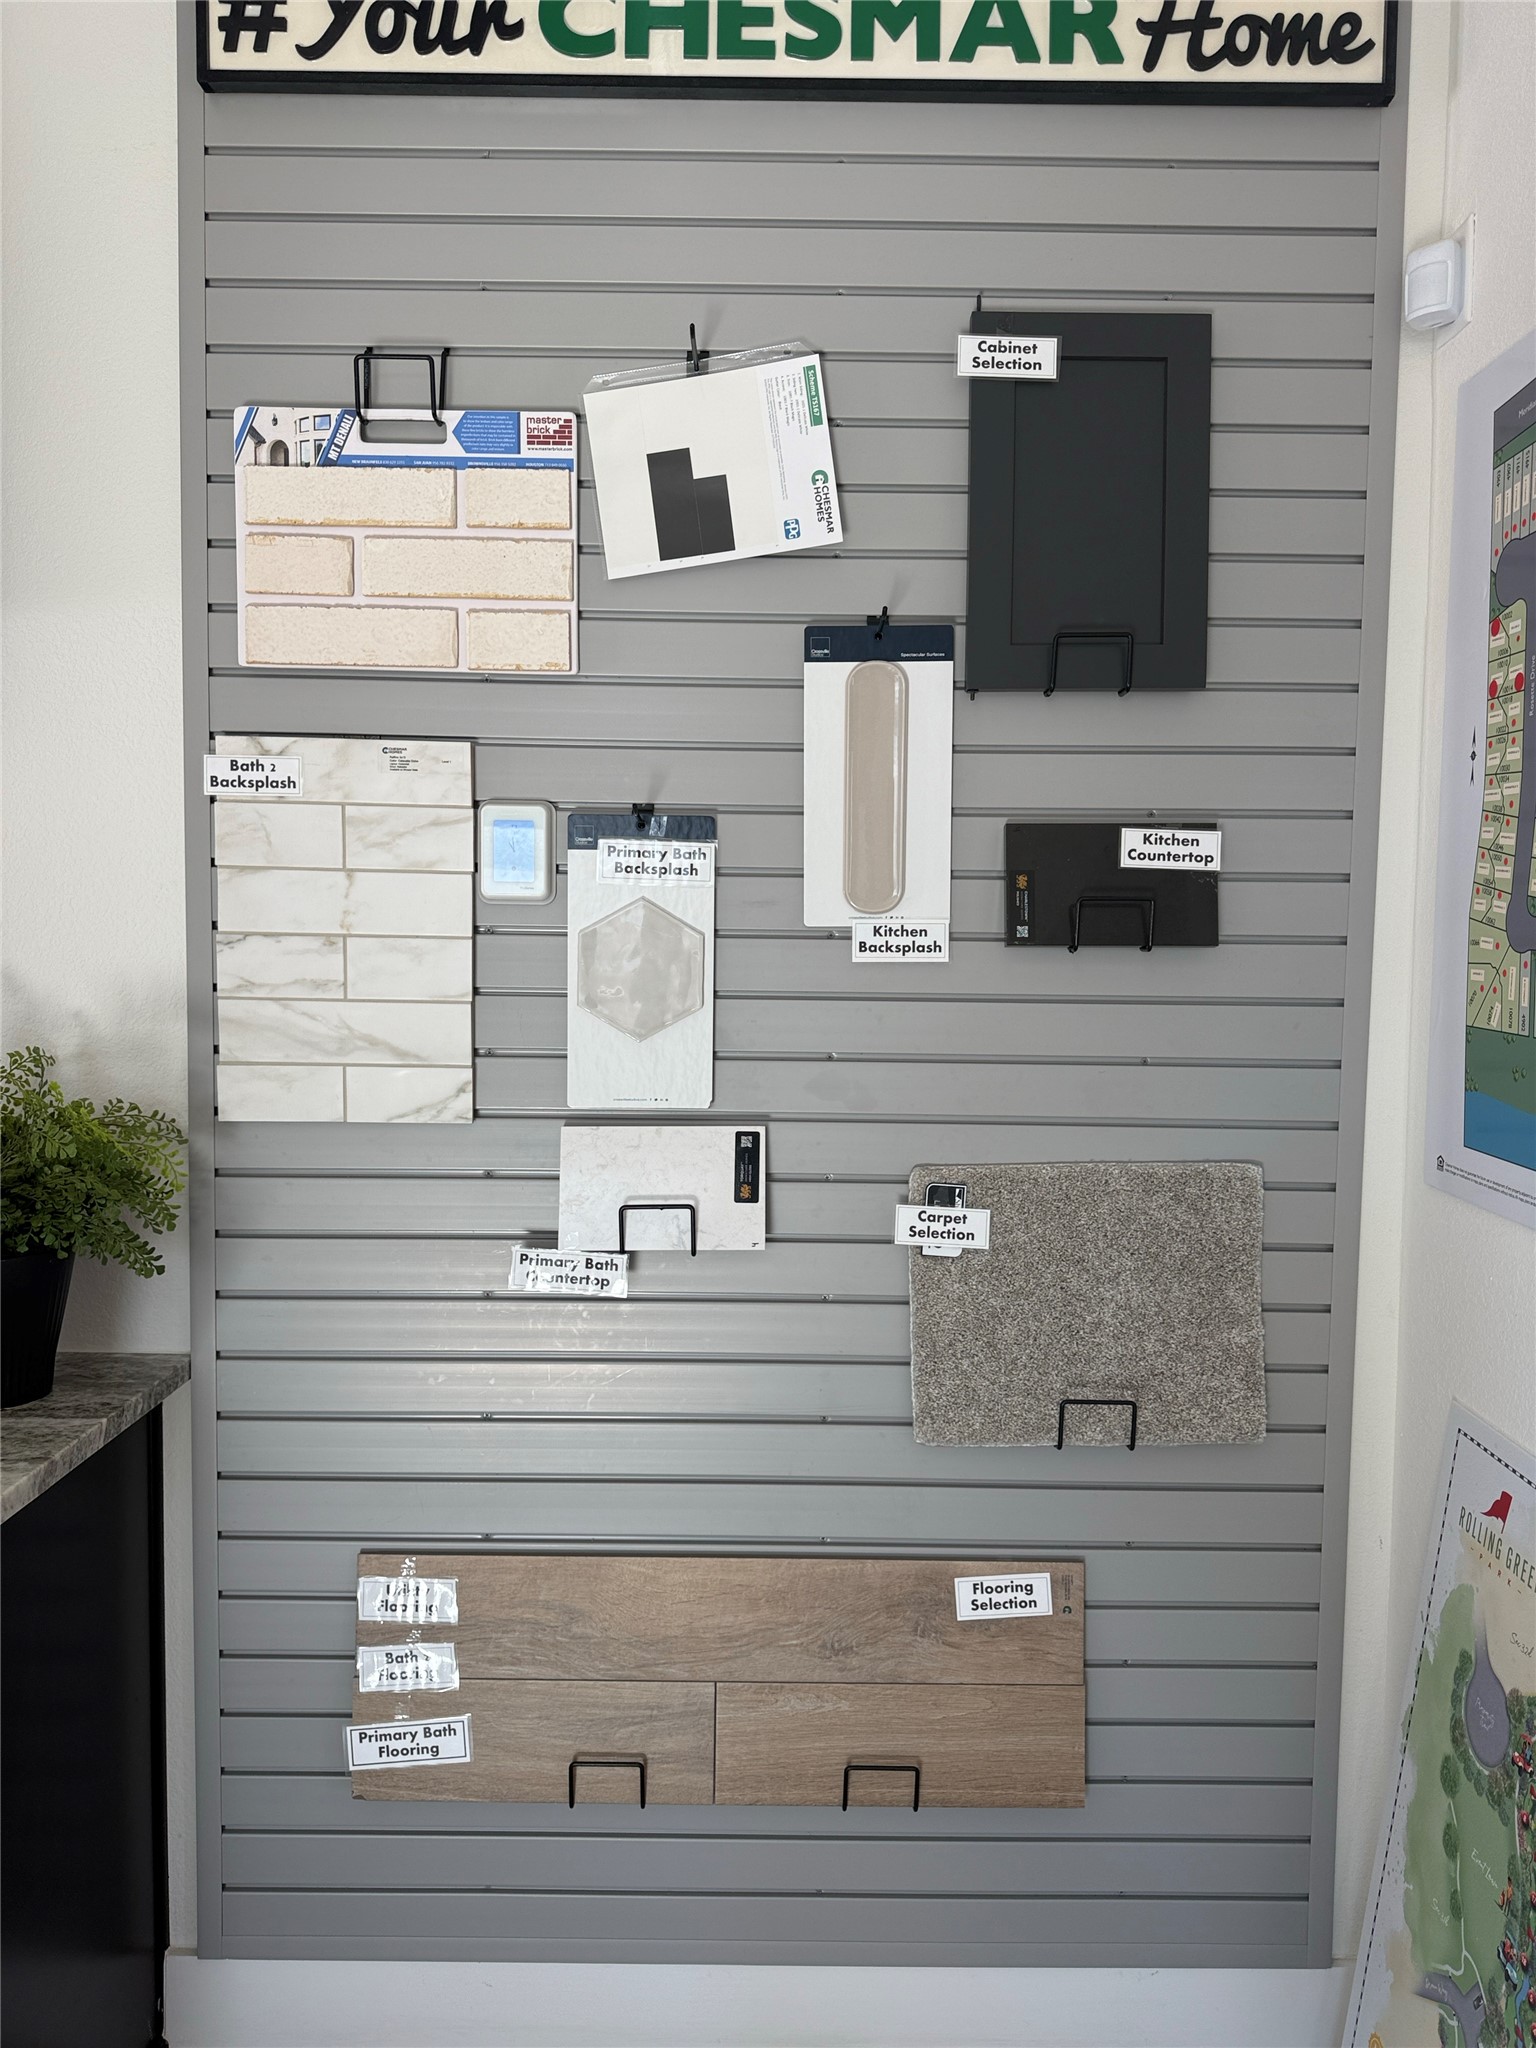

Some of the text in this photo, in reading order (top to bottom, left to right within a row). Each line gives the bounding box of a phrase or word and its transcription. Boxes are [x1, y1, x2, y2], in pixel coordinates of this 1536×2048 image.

[538, 0, 1125, 64] CHESMAR
[1136, 0, 1376, 72] Home
[977, 340, 1038, 354] Cabinet
[972, 356, 1042, 371] Selection
[808, 370, 820, 416] Scheme TS167
[526, 416, 562, 424] master
[328, 414, 354, 460] MT DENALI
[526, 424, 550, 434] brick
[814, 486, 825, 522] HOMES
[822, 485, 834, 534] CHESMAR
[230, 759, 276, 772] Bath 2
[210, 775, 297, 792] Backsplash
[1143, 832, 1200, 847] Kitchen
[607, 845, 706, 862] Primary Bath
[1127, 848, 1214, 867] Countertop
[614, 862, 698, 878] Backsplash
[873, 924, 928, 937] Kitchen
[858, 940, 942, 956] Backsplash
[918, 1210, 968, 1226] Carpet
[908, 1226, 975, 1241] Selection
[520, 1253, 619, 1272] Primary Bath
[526, 1270, 610, 1290] Cntertop
[1458, 1506, 1536, 1594] ROLLING GREE
[972, 1580, 1034, 1596] Flooring
[971, 1596, 1037, 1611] Selection
[385, 1650, 418, 1664] Bath
[358, 1724, 457, 1744] Primary Bath
[378, 1743, 440, 1758] Flooring
